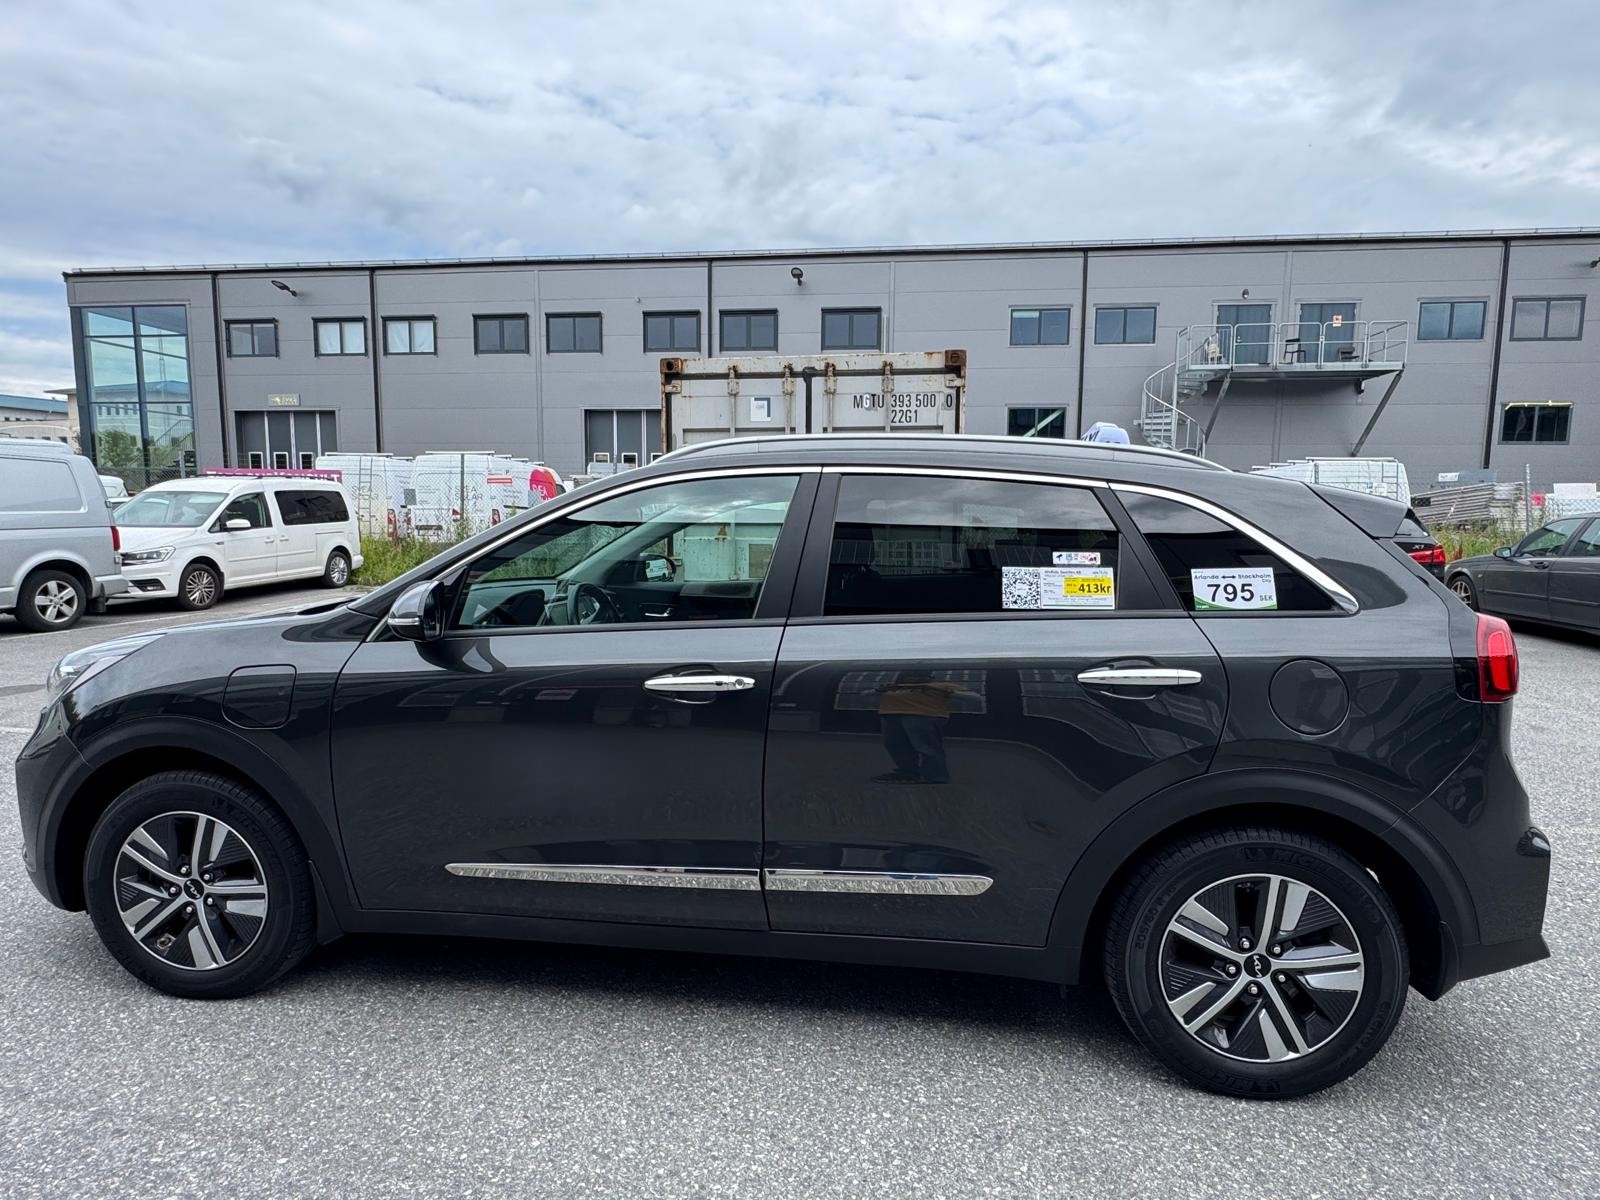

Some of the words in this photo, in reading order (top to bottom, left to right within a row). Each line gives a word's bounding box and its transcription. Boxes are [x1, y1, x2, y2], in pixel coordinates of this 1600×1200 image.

[891, 394, 912, 408] 393
[915, 394, 937, 408] 500
[891, 409, 918, 423] 22G1
[1078, 583, 1112, 594] 413kr
[1206, 583, 1255, 602] 795
[1259, 594, 1274, 602] SEK
